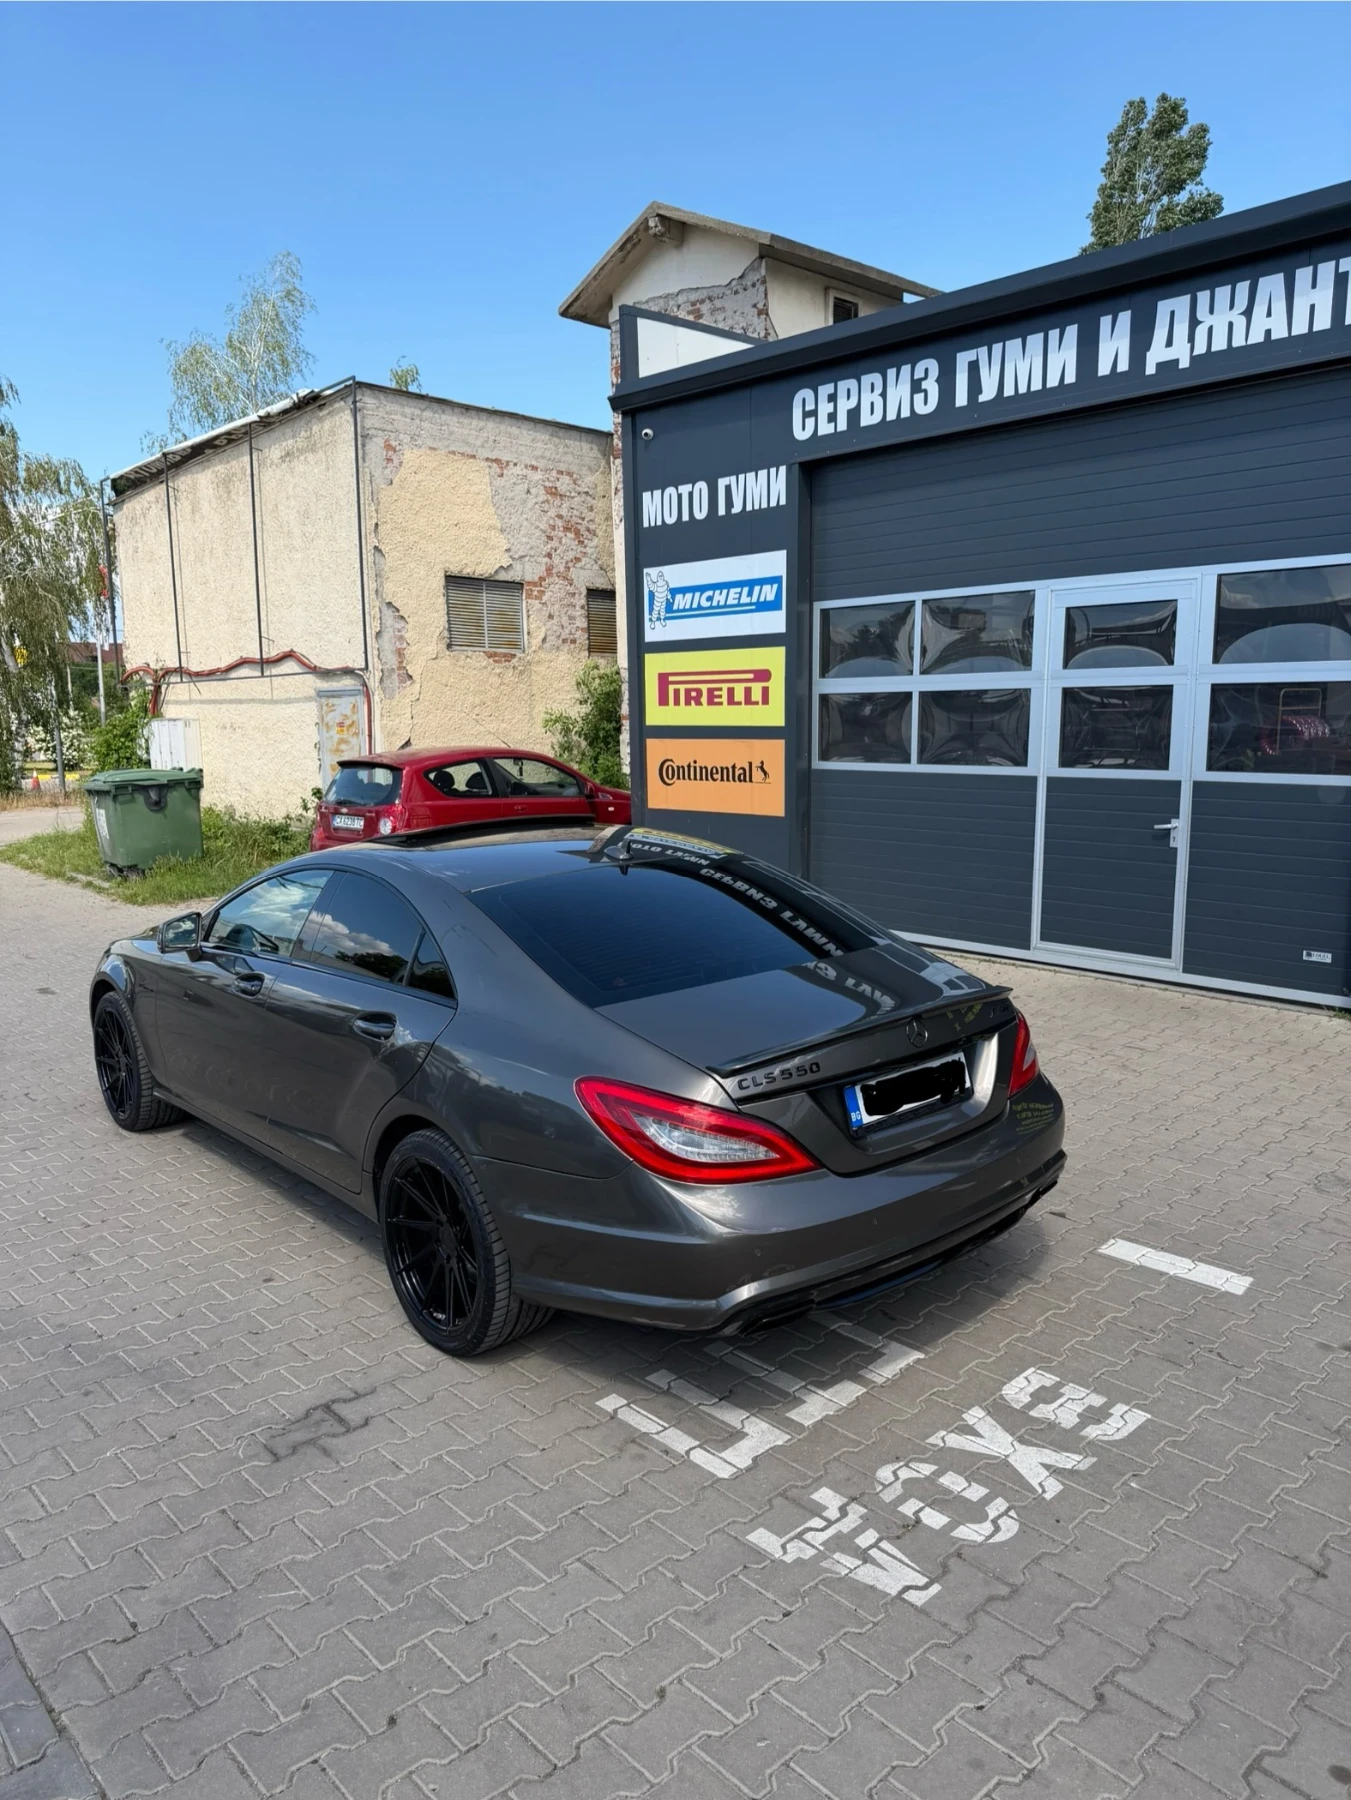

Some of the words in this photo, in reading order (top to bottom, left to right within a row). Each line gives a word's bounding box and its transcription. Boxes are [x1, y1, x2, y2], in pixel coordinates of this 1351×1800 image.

[792, 358, 939, 441] СЕРВИЗ
[955, 324, 1078, 408] ГУМИ
[1097, 310, 1131, 377] И
[642, 481, 708, 528] МОТО
[717, 465, 786, 516] ГУМИ
[673, 583, 778, 611] MICHELIN
[658, 668, 772, 707] PIRELLI
[658, 758, 753, 786] Continental
[851, 1111, 861, 1122] BG
[745, 1366, 1151, 1606] ВХОД
